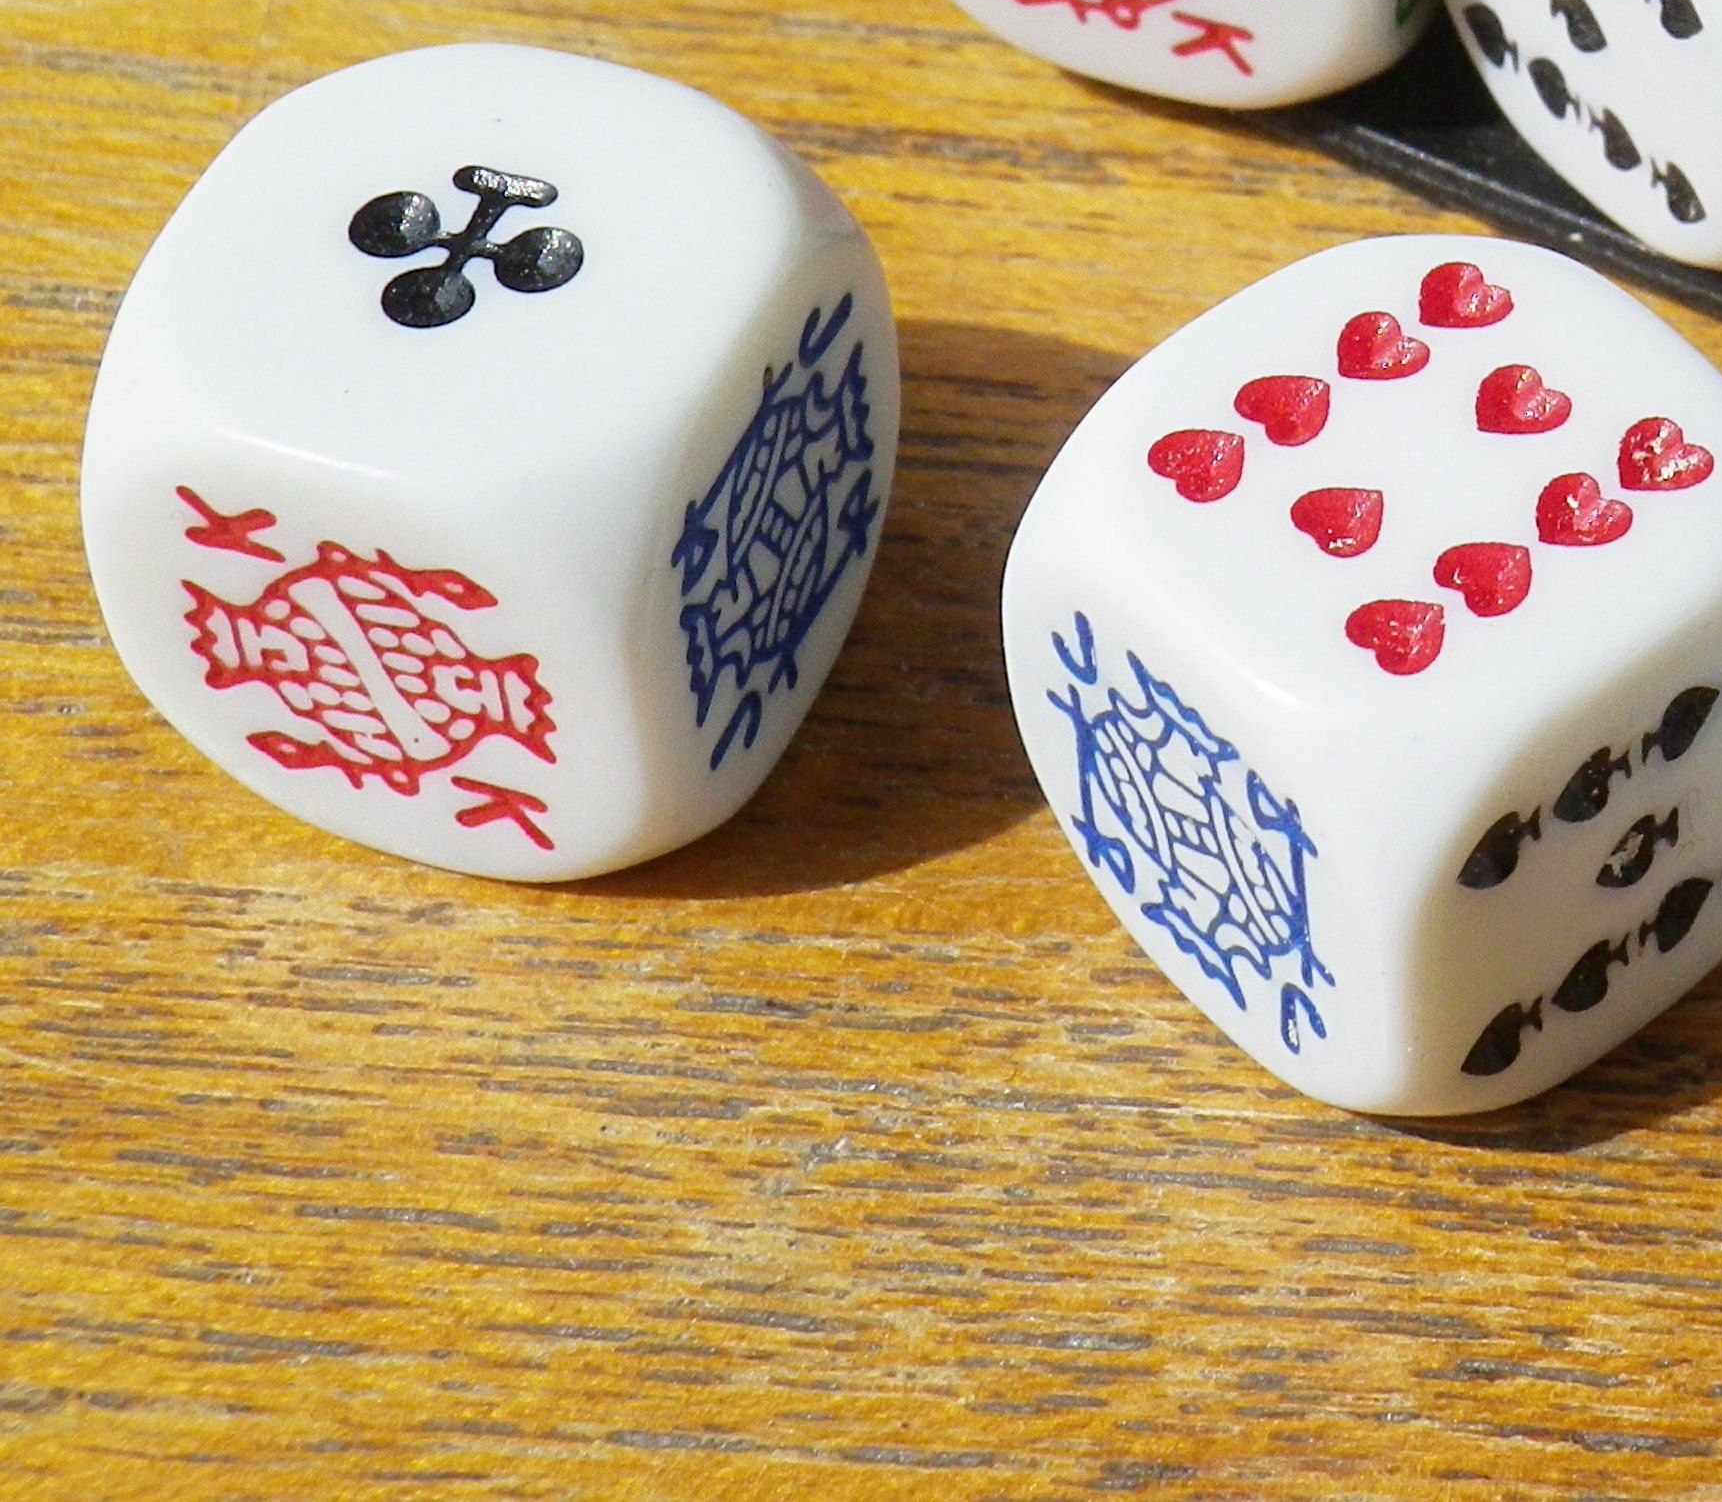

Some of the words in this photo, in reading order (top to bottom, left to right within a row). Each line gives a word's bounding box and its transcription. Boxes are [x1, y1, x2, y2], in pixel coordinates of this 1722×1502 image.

[1172, 11, 1252, 76] K
[800, 292, 854, 368] J
[176, 485, 286, 562] K
[1051, 610, 1096, 685] J
[451, 776, 555, 851] K
[1281, 981, 1326, 1054] J
